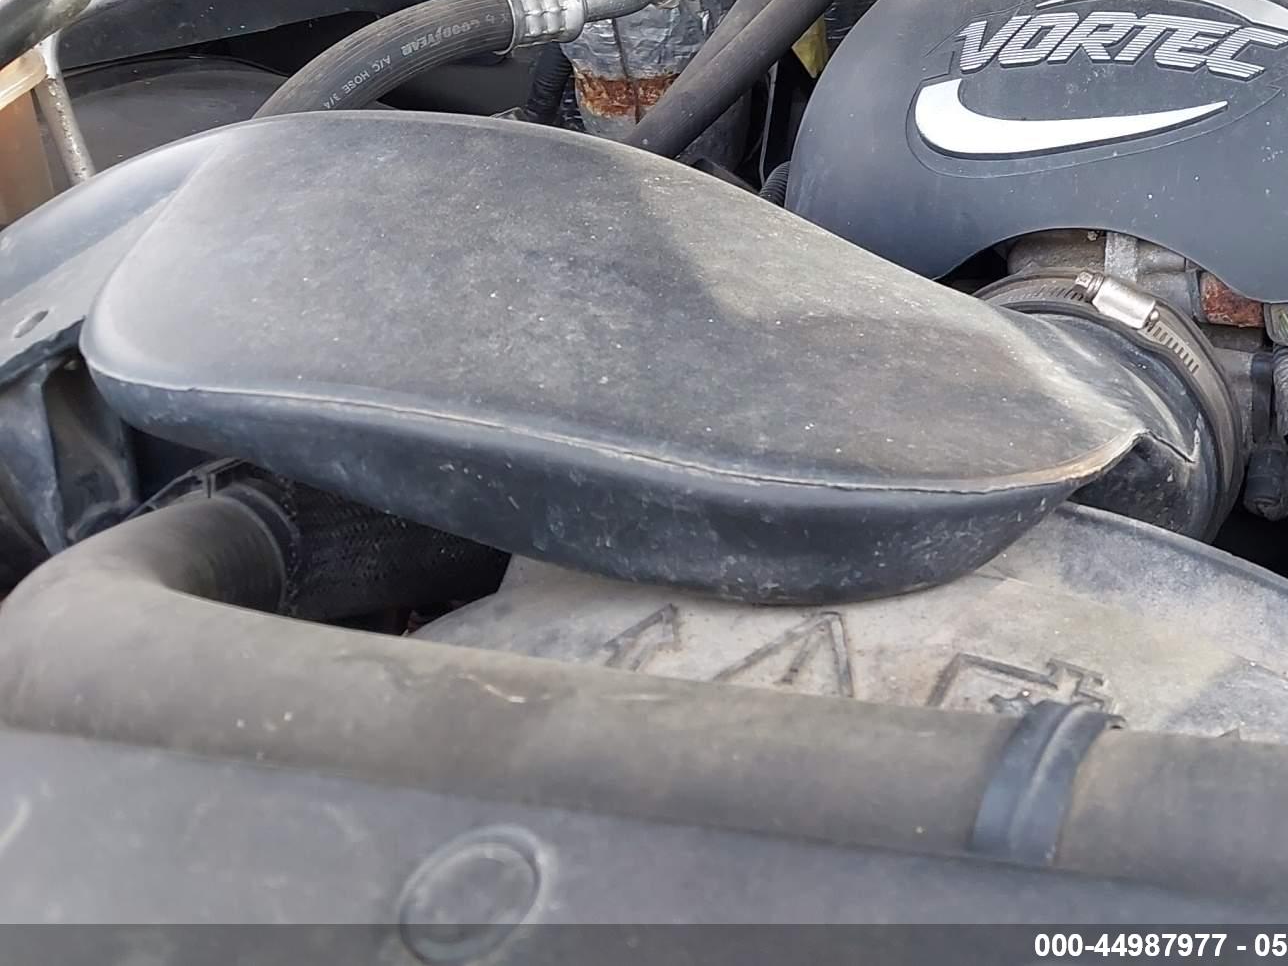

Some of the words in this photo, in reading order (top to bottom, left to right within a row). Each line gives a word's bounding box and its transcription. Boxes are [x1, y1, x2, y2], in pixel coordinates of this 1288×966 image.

[400, 19, 481, 57] GOODYEAR
[371, 54, 392, 74] A/C
[342, 69, 371, 95] HOSE
